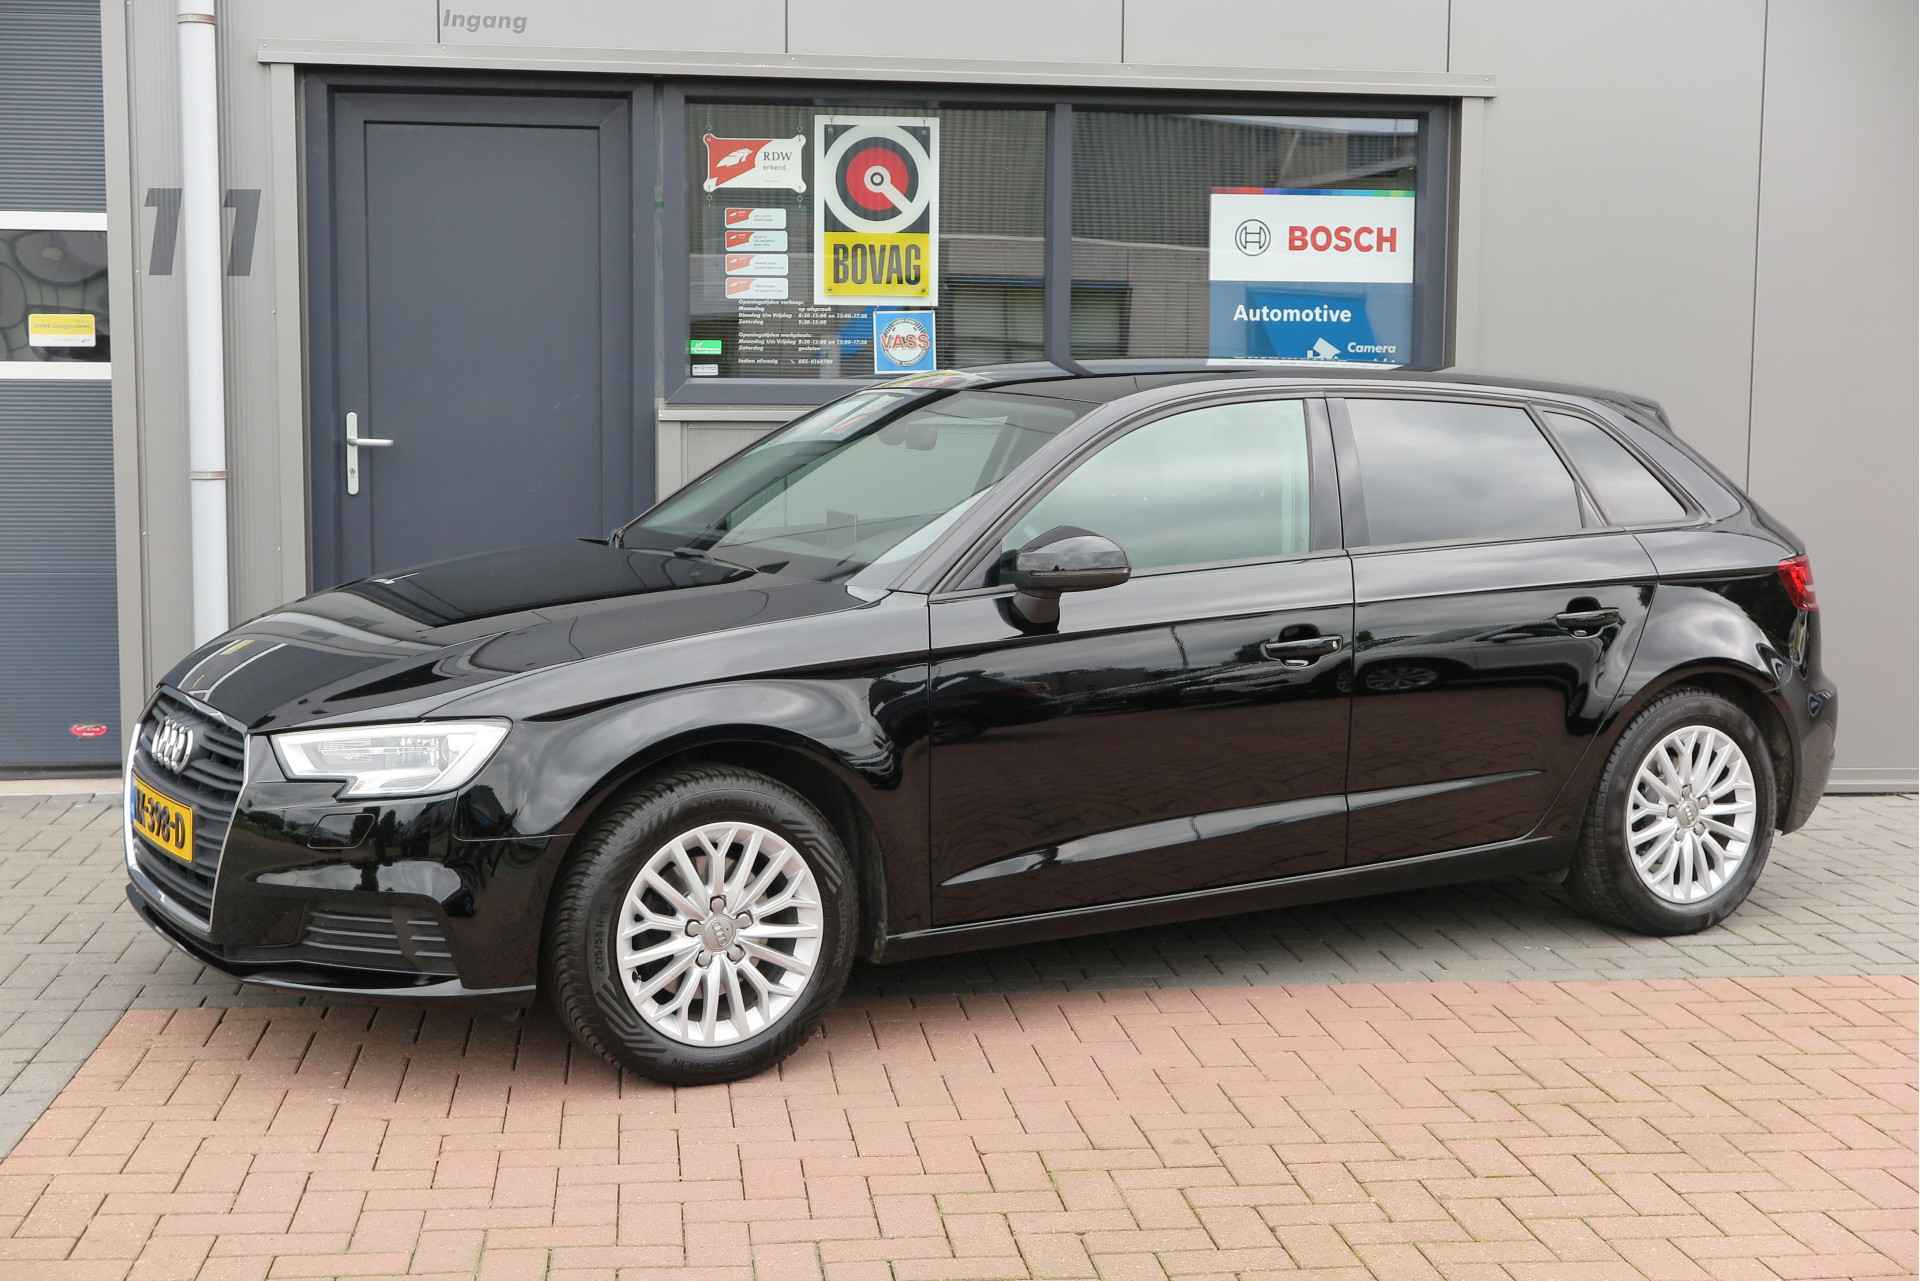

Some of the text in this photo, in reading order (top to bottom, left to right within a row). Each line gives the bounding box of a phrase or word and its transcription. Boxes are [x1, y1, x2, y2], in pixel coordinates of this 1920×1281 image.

[443, 9, 527, 34] Ingang
[763, 152, 792, 161] RDW
[1288, 226, 1397, 252] BOSCH
[833, 243, 921, 285] BOVAG
[1233, 304, 1352, 322] Automotive
[880, 334, 930, 349] VASS
[1347, 341, 1397, 354] Camera
